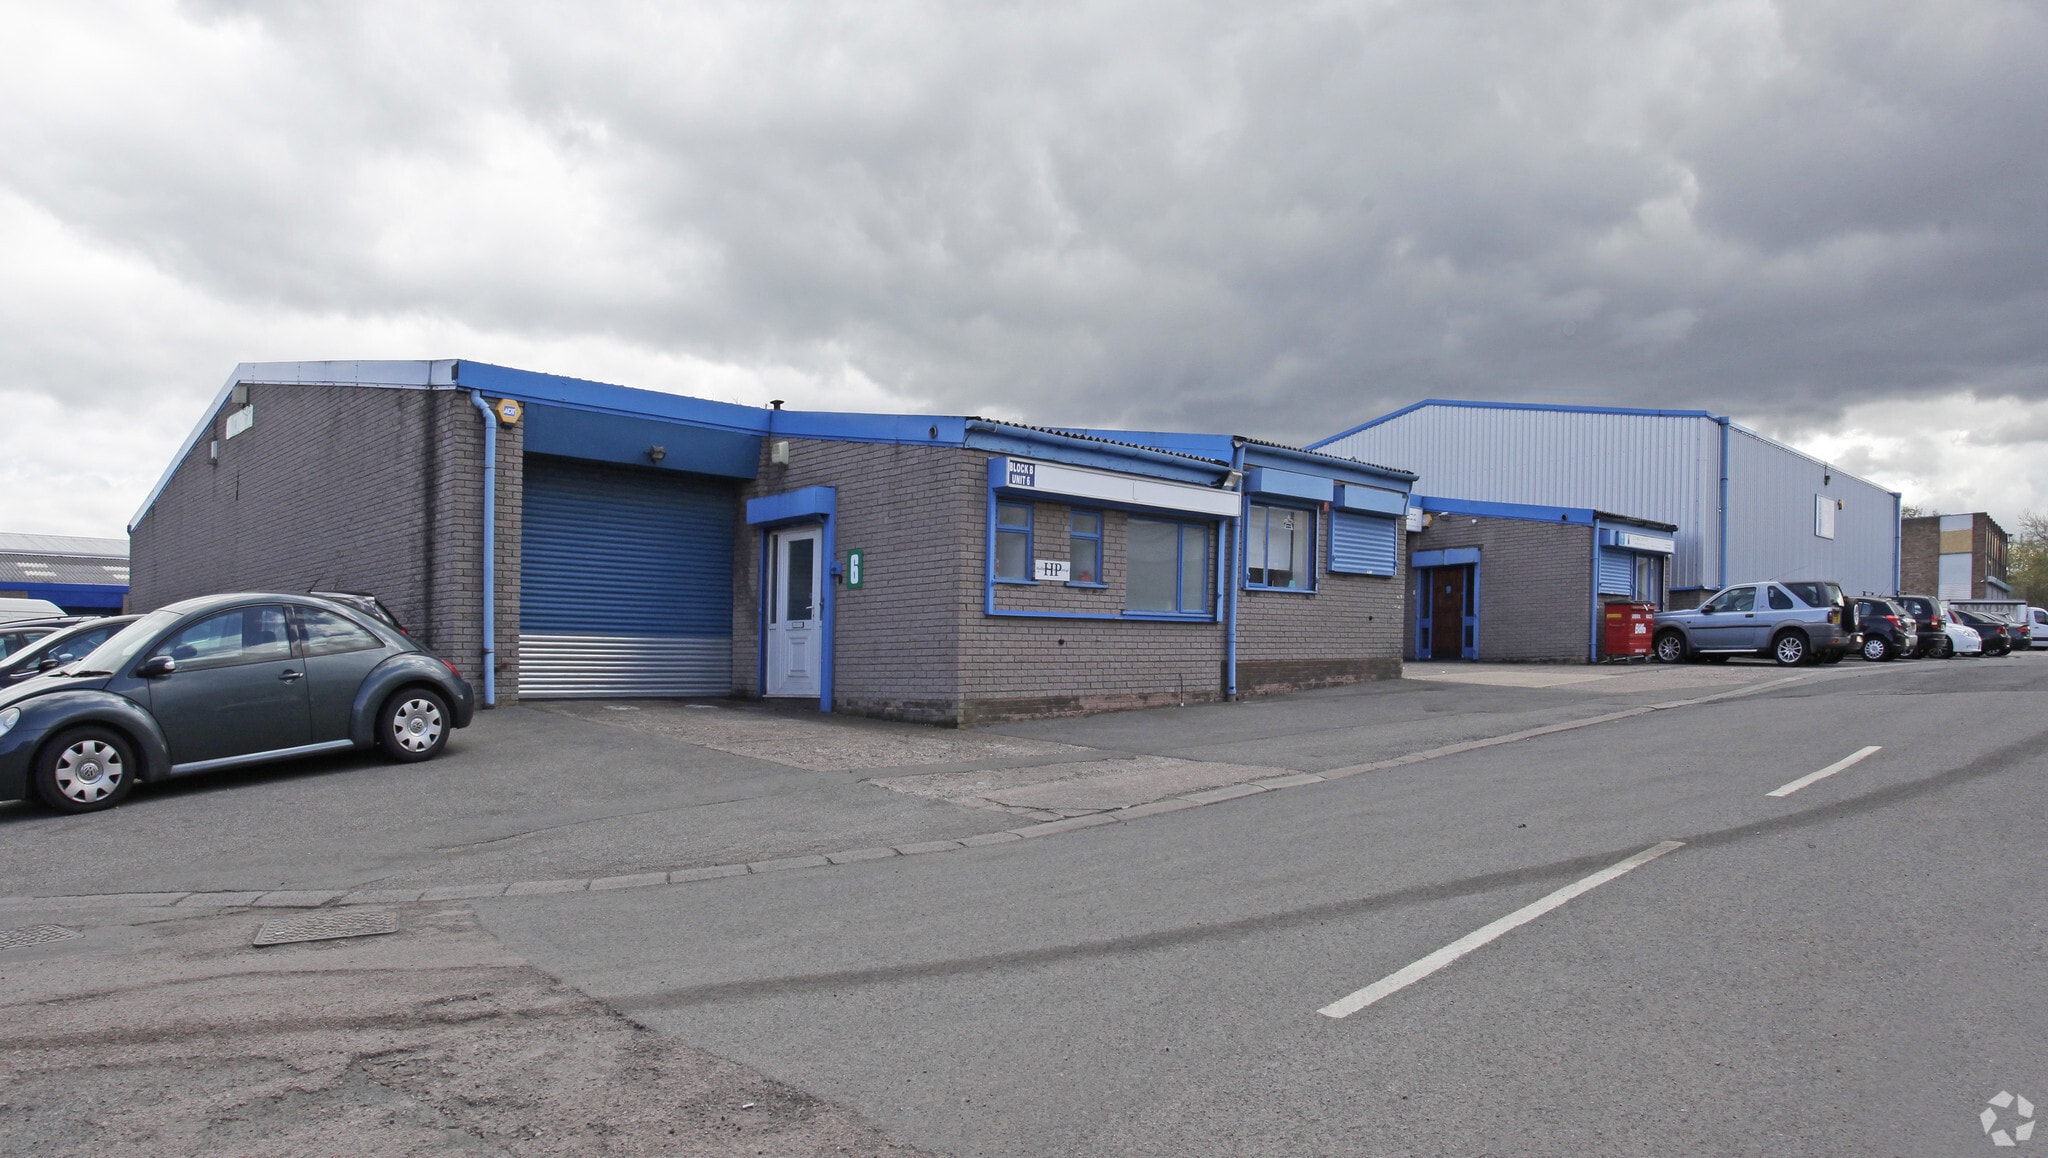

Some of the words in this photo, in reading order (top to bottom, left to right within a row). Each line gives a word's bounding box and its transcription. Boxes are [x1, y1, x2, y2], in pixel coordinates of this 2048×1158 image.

[1010, 462, 1029, 474] BLOCK
[1029, 465, 1034, 475] B
[1011, 474, 1026, 485] UNIT
[1026, 476, 1031, 486] 6
[850, 554, 859, 584] 6
[1043, 562, 1062, 577] HP
